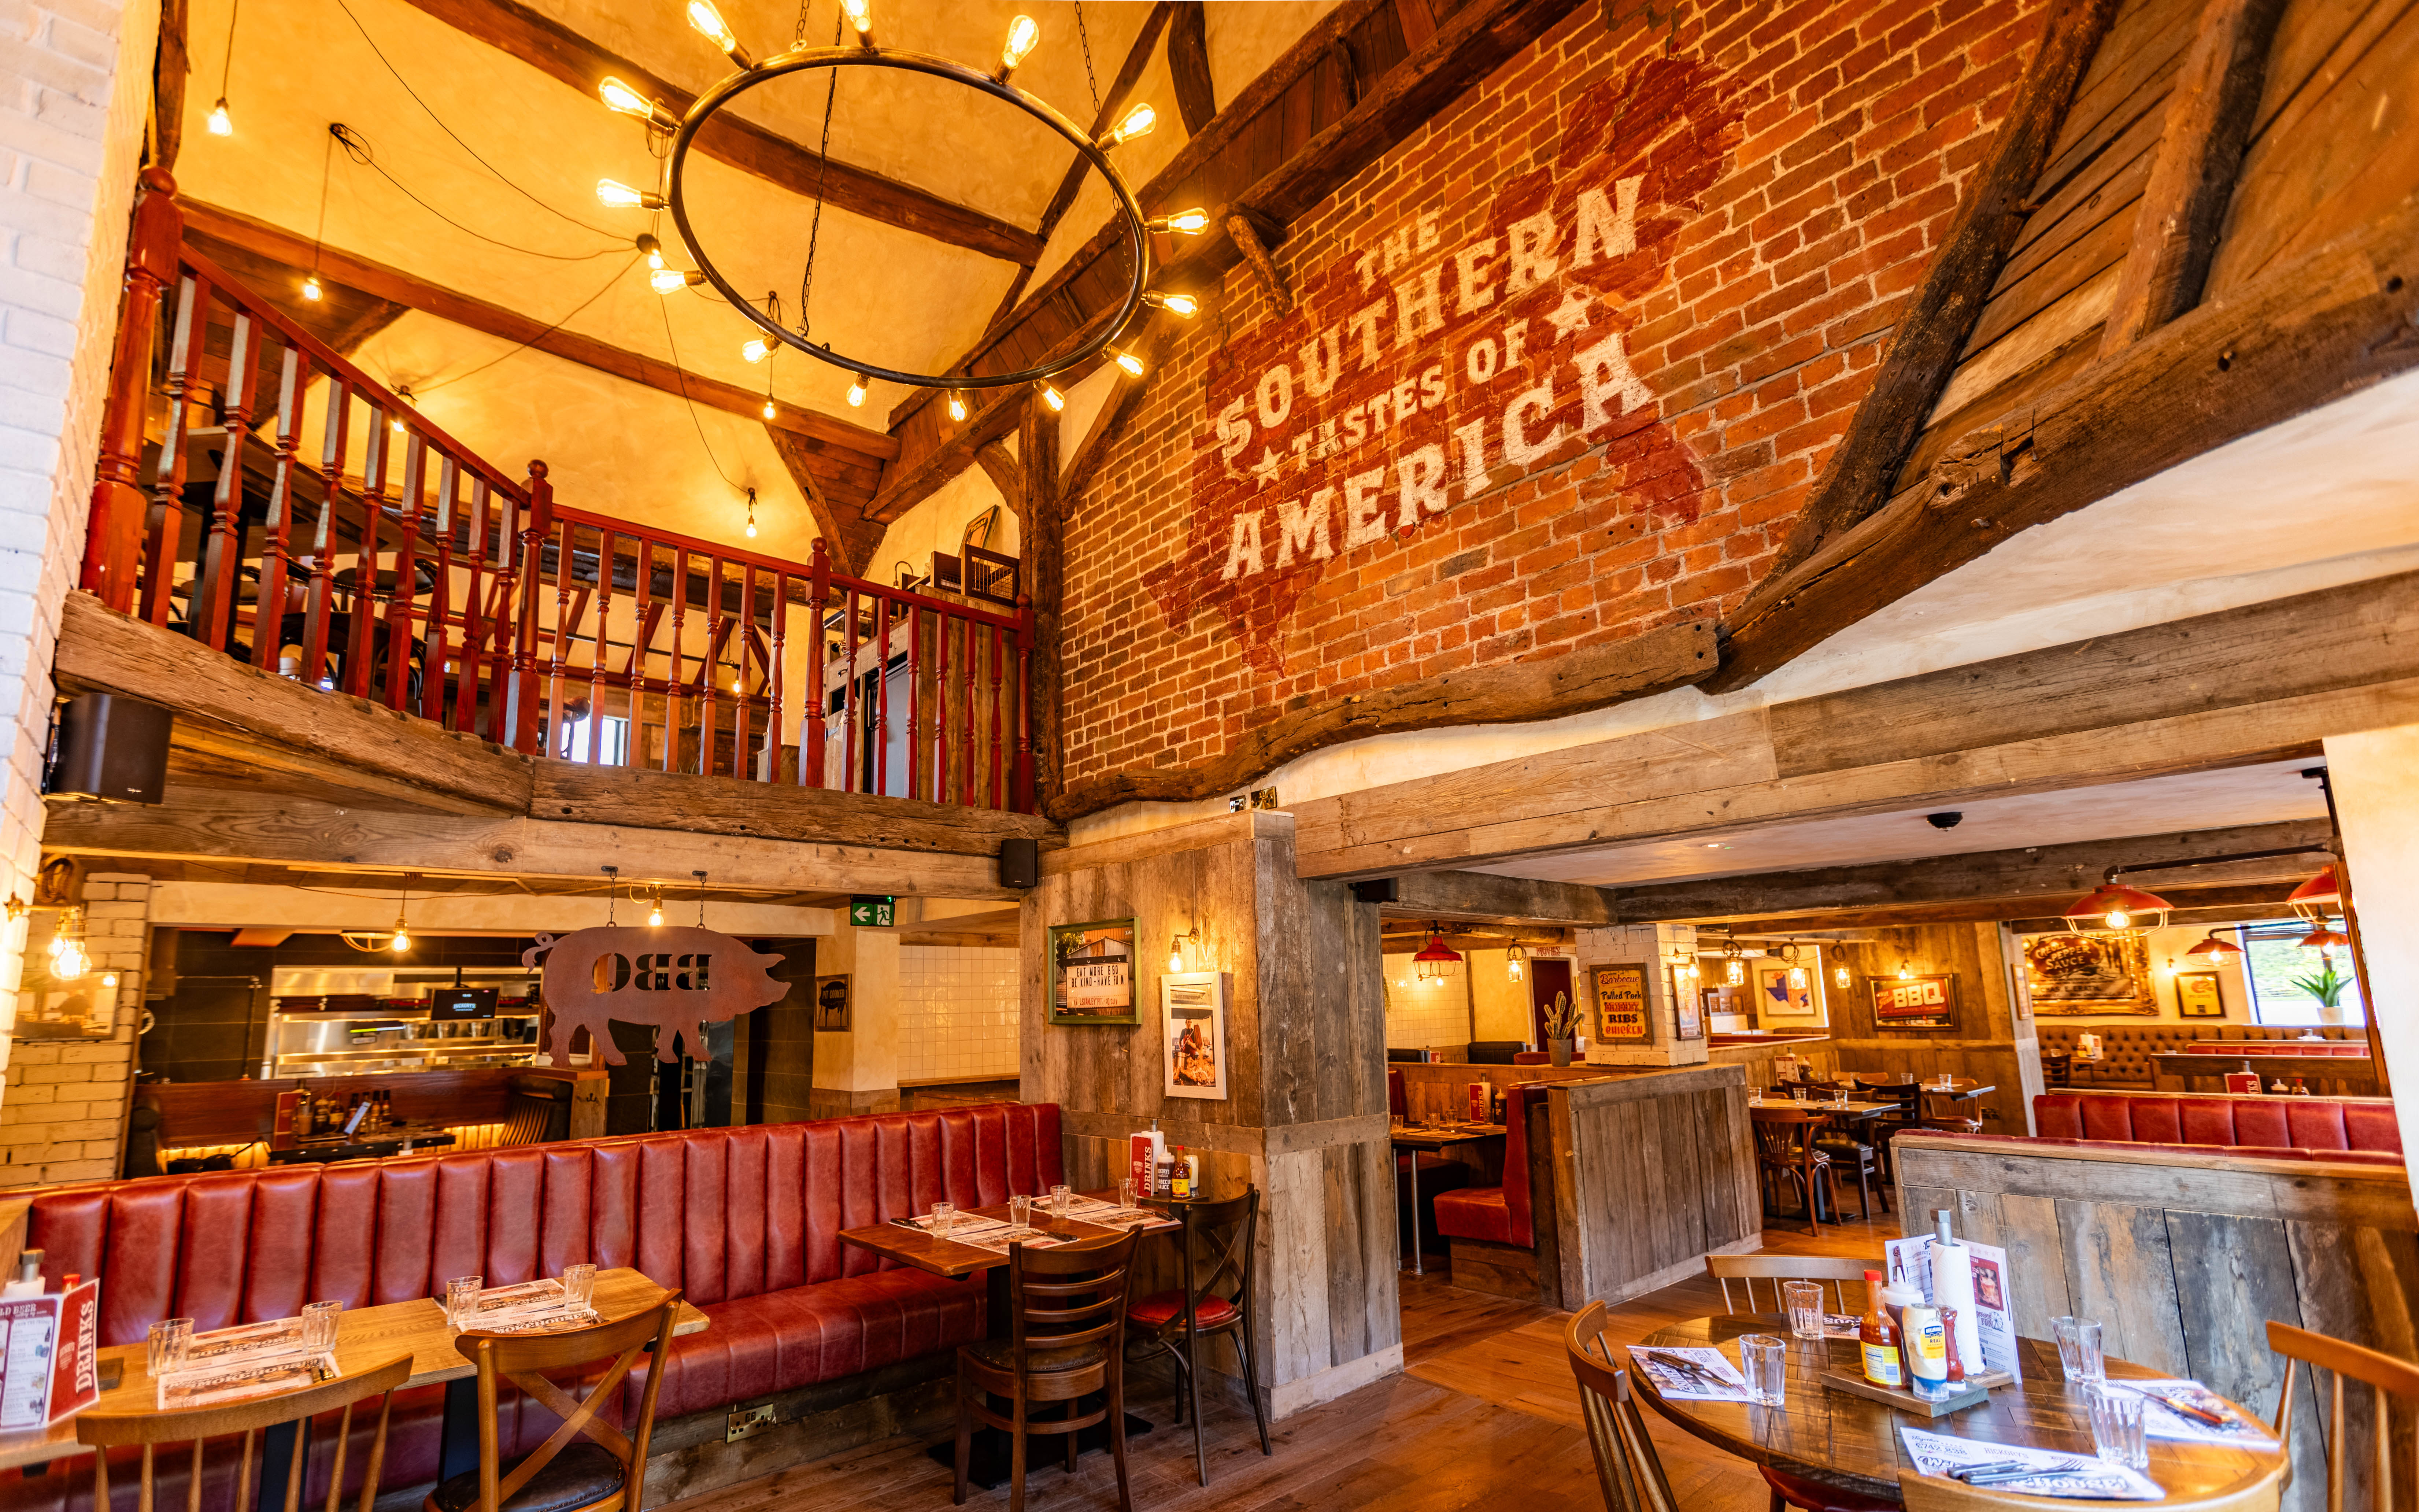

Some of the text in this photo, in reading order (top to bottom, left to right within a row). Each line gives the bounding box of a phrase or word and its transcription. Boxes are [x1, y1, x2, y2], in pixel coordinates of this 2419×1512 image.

[1355, 207, 1441, 291] THE
[1216, 174, 1646, 459] SOUTHERN
[1292, 318, 1530, 471] TASTES OF
[1221, 332, 1654, 581] AMERICA
[2035, 942, 2067, 959] CREOLE
[2050, 945, 2091, 961] PEPPER
[2046, 955, 2086, 970] SAUCE
[1077, 967, 1086, 977] EAT
[1090, 966, 1103, 976] MORE
[1600, 974, 1639, 984] Barbecue
[1072, 978, 1077, 987] BE
[830, 989, 845, 999] COOKED
[1601, 991, 1642, 1000] Pulled Pork
[1893, 982, 1945, 1008] BBQ
[1604, 1001, 1639, 1012] BRISKET
[1608, 1014, 1638, 1024] RIBS
[1606, 1025, 1643, 1035] CHICKEN
[76, 1300, 94, 1397] DRINKS
